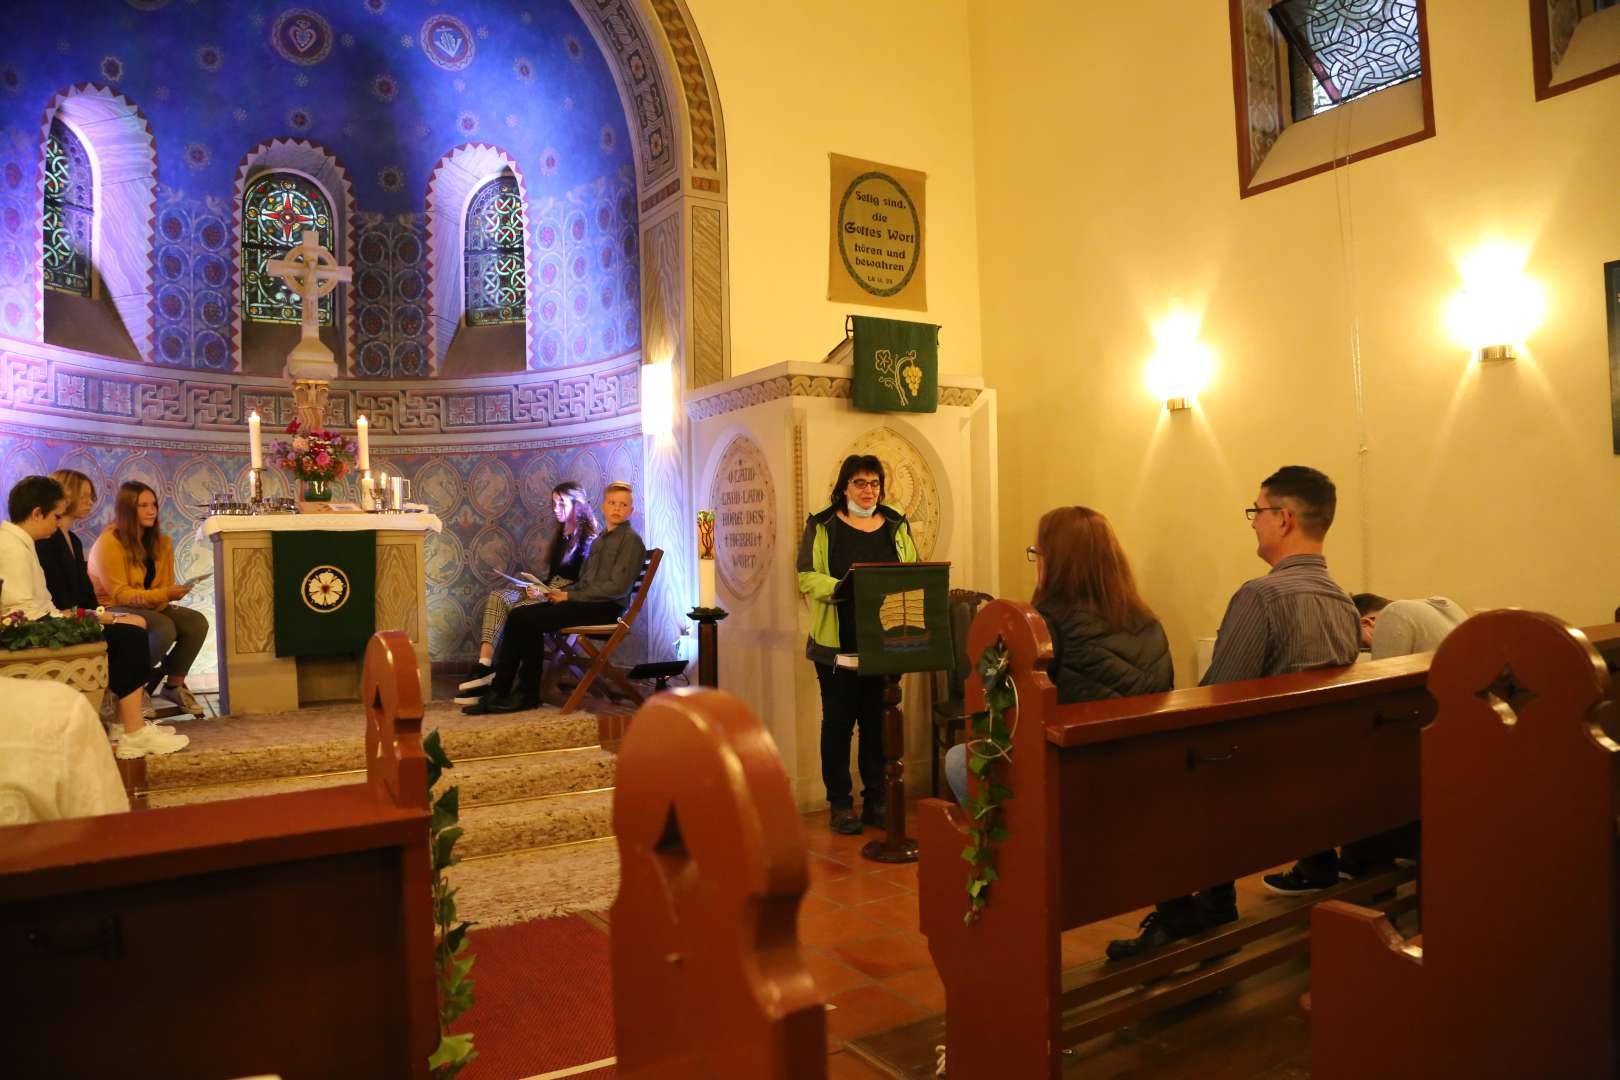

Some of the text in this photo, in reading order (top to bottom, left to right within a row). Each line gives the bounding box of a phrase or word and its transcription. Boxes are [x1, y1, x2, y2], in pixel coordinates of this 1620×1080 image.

[856, 191, 880, 206] Selig
[872, 212, 887, 223] die
[844, 222, 914, 244] Gottes Wort
[886, 249, 905, 259] und
[855, 257, 905, 271] bewahren
[732, 554, 756, 568] WORT
